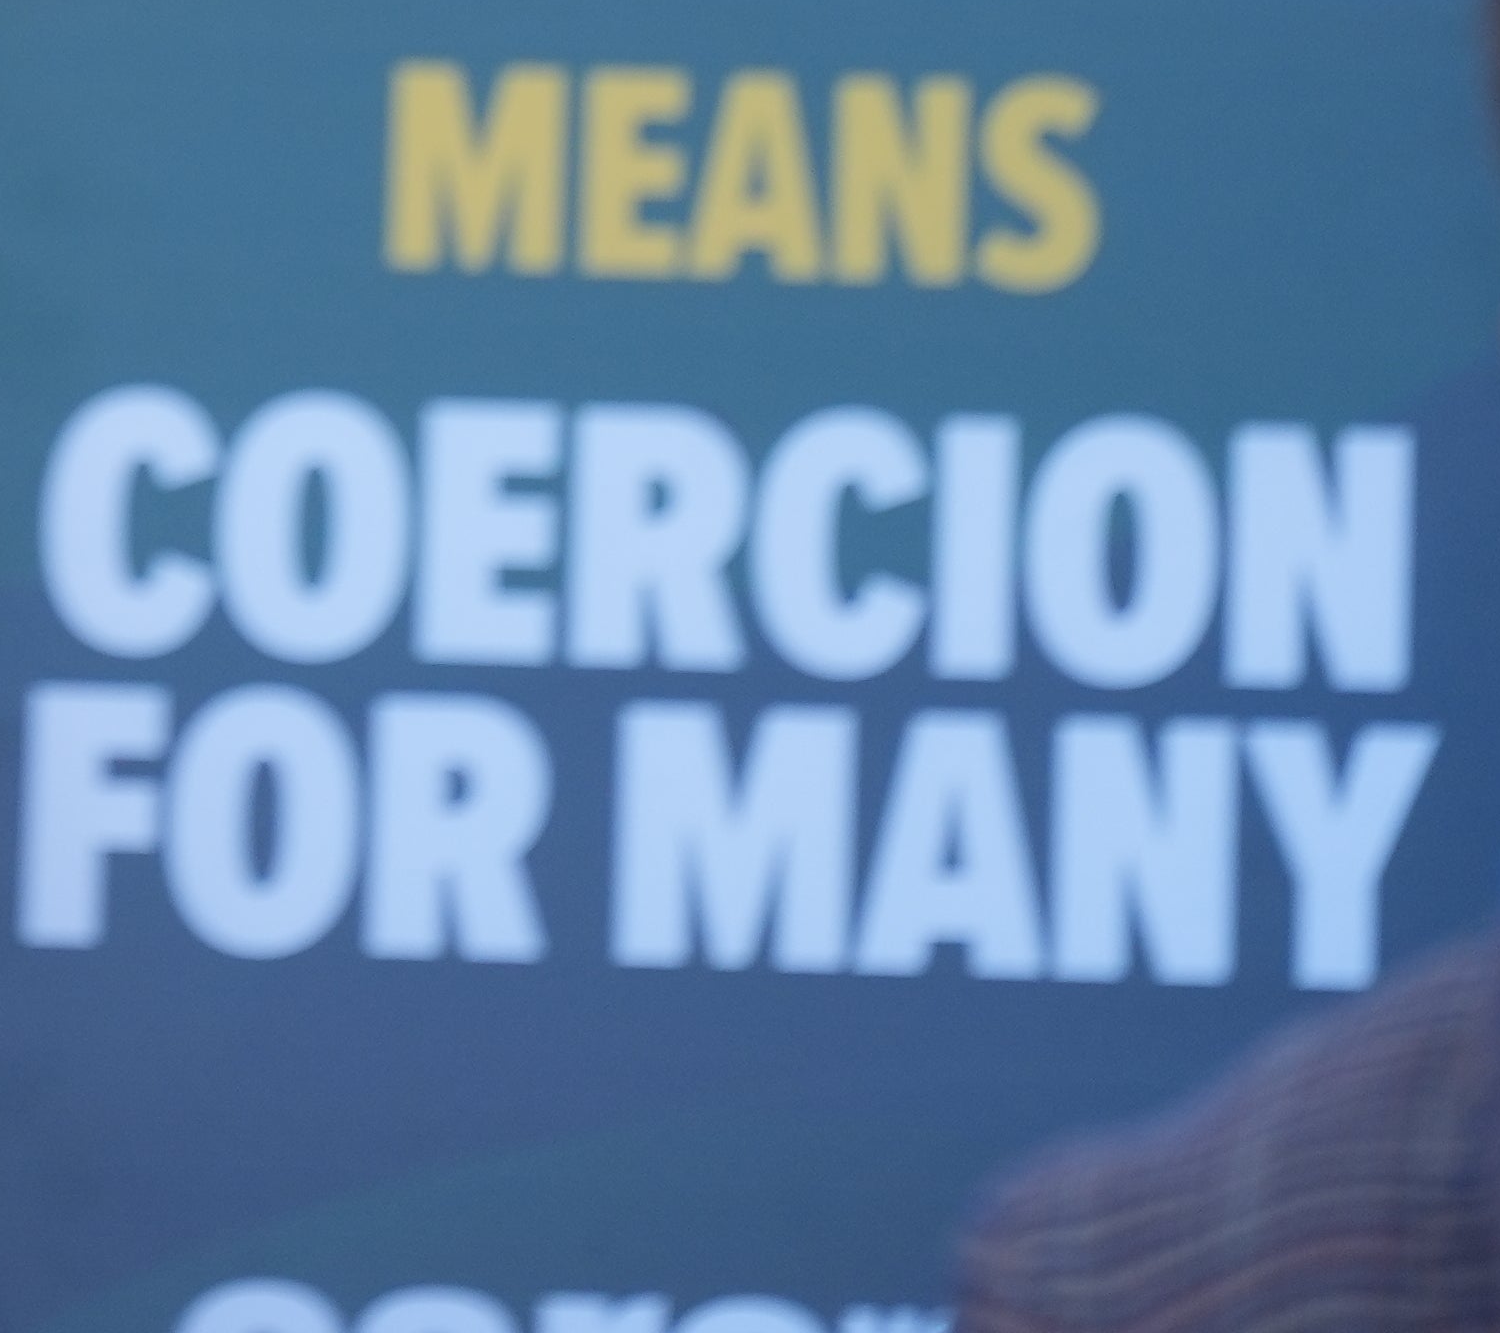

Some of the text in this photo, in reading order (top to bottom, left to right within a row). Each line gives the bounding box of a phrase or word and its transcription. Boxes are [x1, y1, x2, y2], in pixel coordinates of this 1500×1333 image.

[385, 61, 1100, 293] MEANS
[37, 383, 1416, 691] COERCION
[17, 682, 1442, 992] FOR MANY
